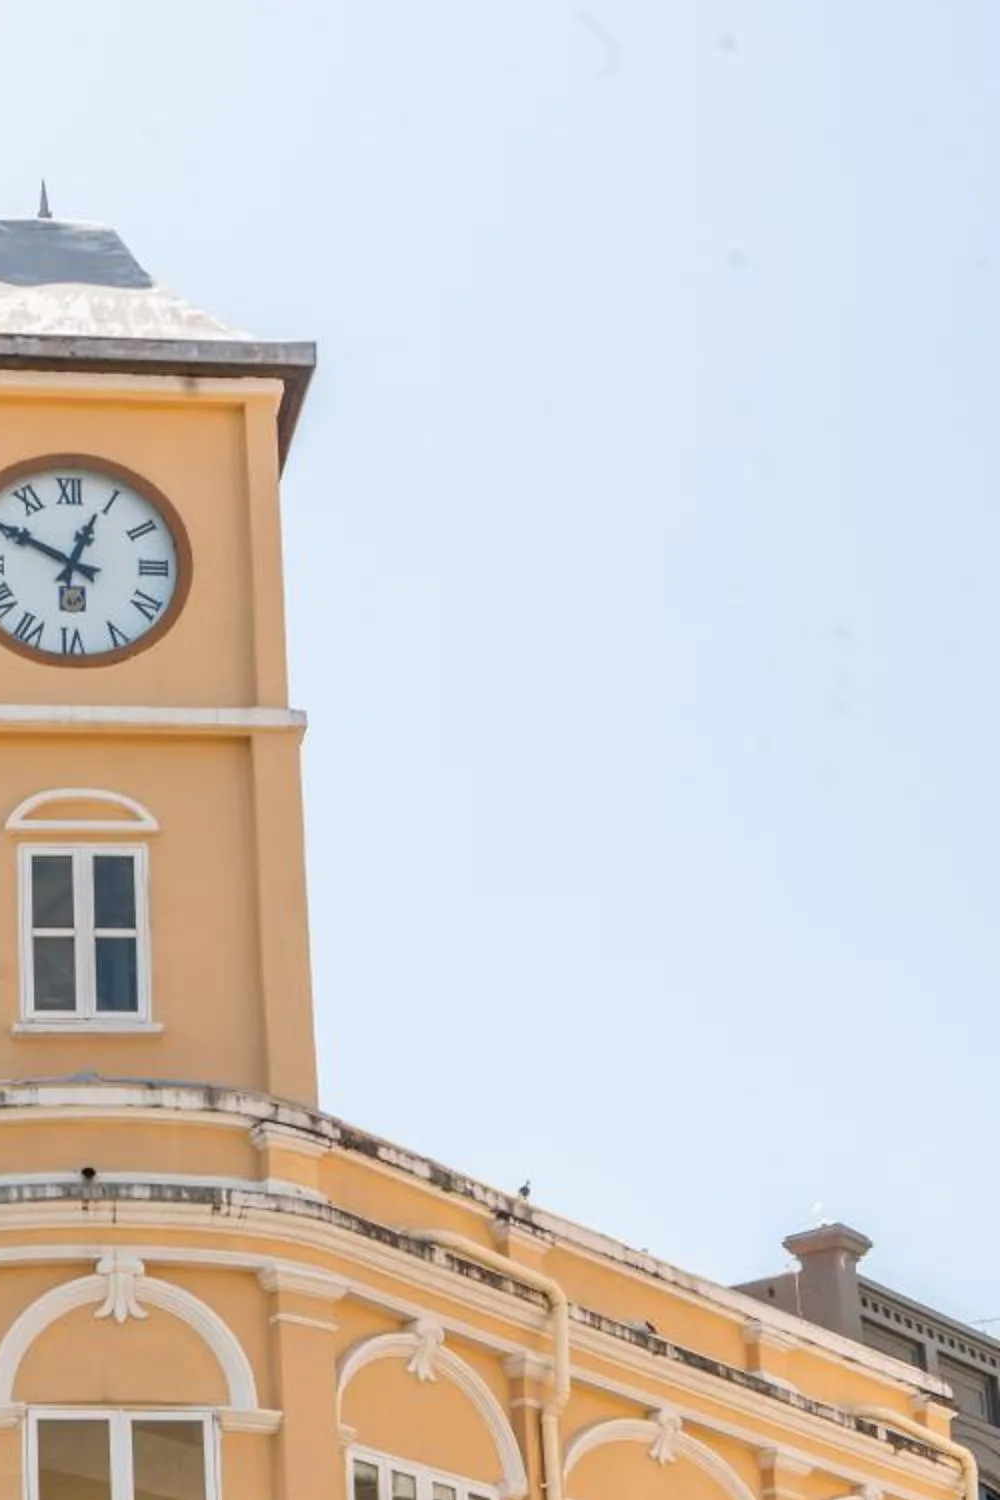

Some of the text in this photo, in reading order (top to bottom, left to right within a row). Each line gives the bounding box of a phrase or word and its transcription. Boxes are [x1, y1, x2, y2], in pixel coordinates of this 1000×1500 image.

[13, 484, 45, 516] XI
[56, 477, 83, 505] XII
[126, 519, 157, 541] II
[138, 559, 169, 577] III
[130, 589, 163, 623] IV
[14, 612, 45, 649] VII
[60, 627, 86, 656] VI
[106, 620, 131, 649] V
